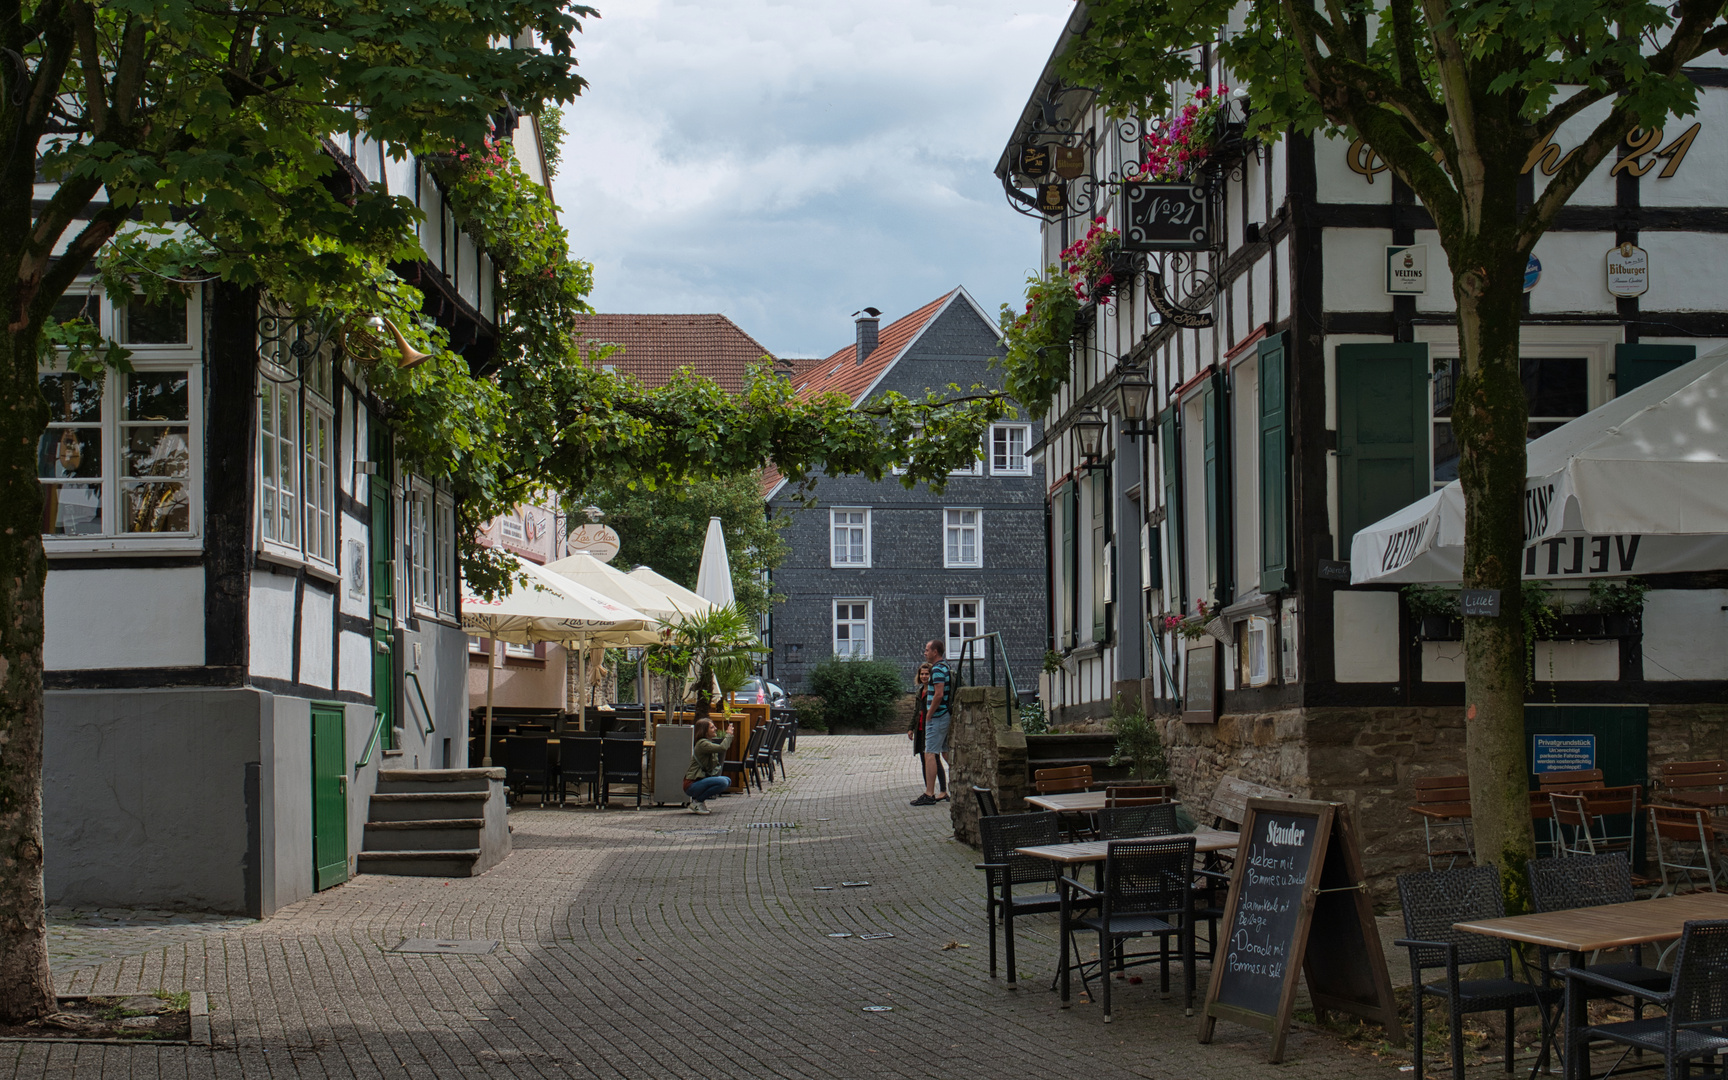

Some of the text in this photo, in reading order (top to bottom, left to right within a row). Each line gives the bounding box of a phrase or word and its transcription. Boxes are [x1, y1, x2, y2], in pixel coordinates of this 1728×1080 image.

[1610, 122, 1702, 179] 21
[1394, 269, 1423, 278] VELTINS
[1609, 263, 1646, 276] Bitburger
[572, 530, 616, 544] Las Olas
[1465, 595, 1494, 607] Lillet
[1538, 739, 1591, 747] Privatgrundstück
[1266, 820, 1305, 847] Stauder
[1280, 856, 1295, 871] mit
[1247, 867, 1281, 887] Pommes
[1238, 910, 1268, 934] Beilage
[1227, 952, 1261, 974] Pommes
